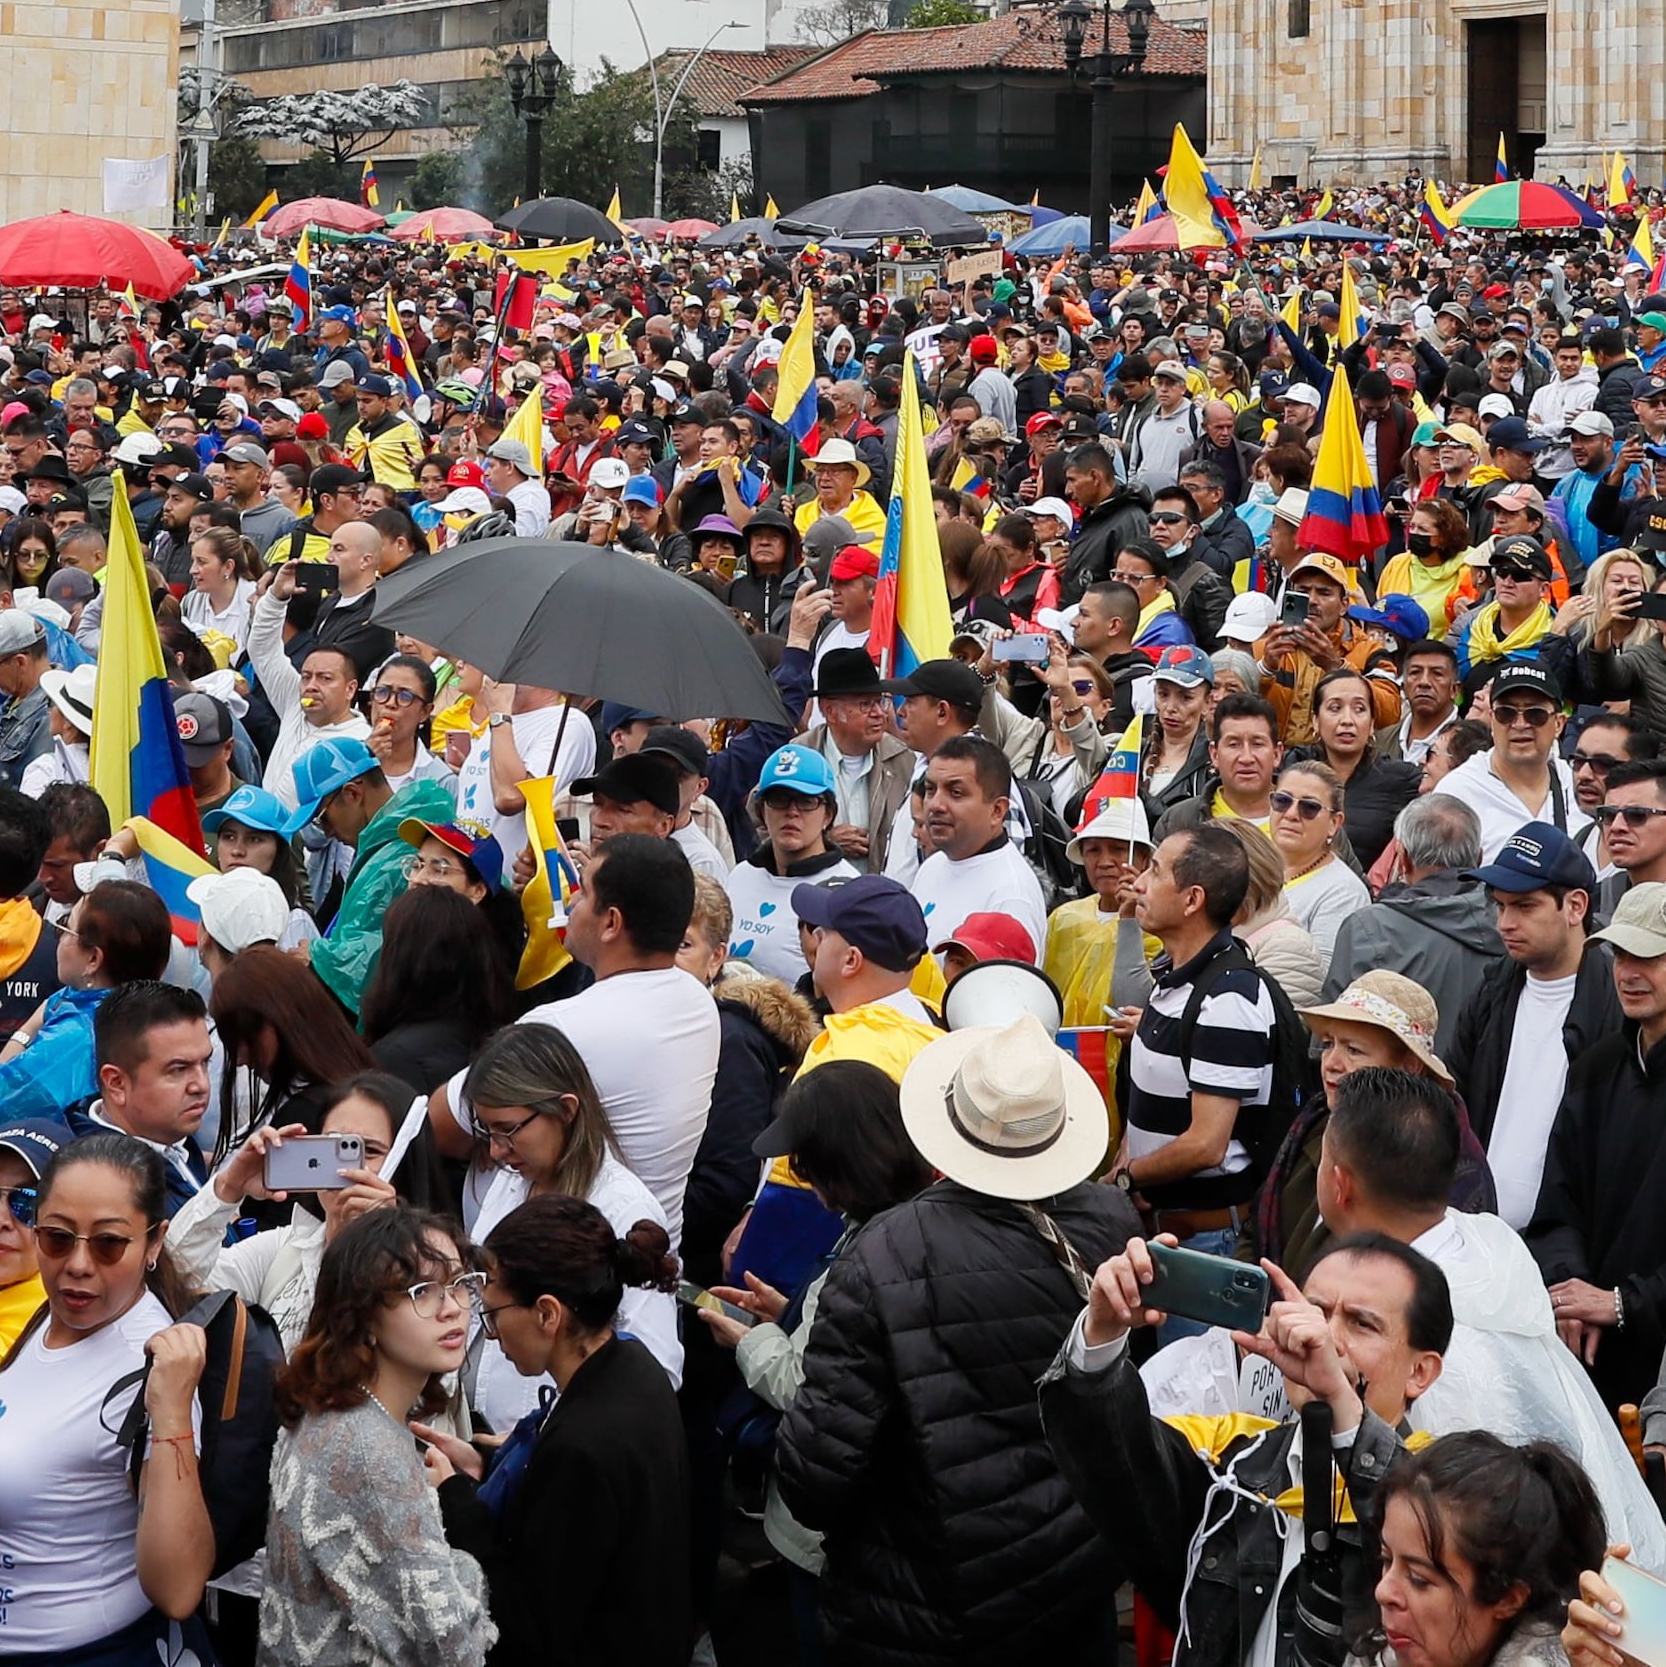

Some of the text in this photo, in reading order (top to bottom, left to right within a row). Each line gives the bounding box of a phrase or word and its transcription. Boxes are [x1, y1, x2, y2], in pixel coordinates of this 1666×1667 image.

[1511, 666, 1546, 681] Bobcat
[738, 918, 775, 936] YO SOY
[5, 981, 40, 998] YORK
[25, 1131, 60, 1154] AÉRE
[1261, 1387, 1282, 1419] SIN
